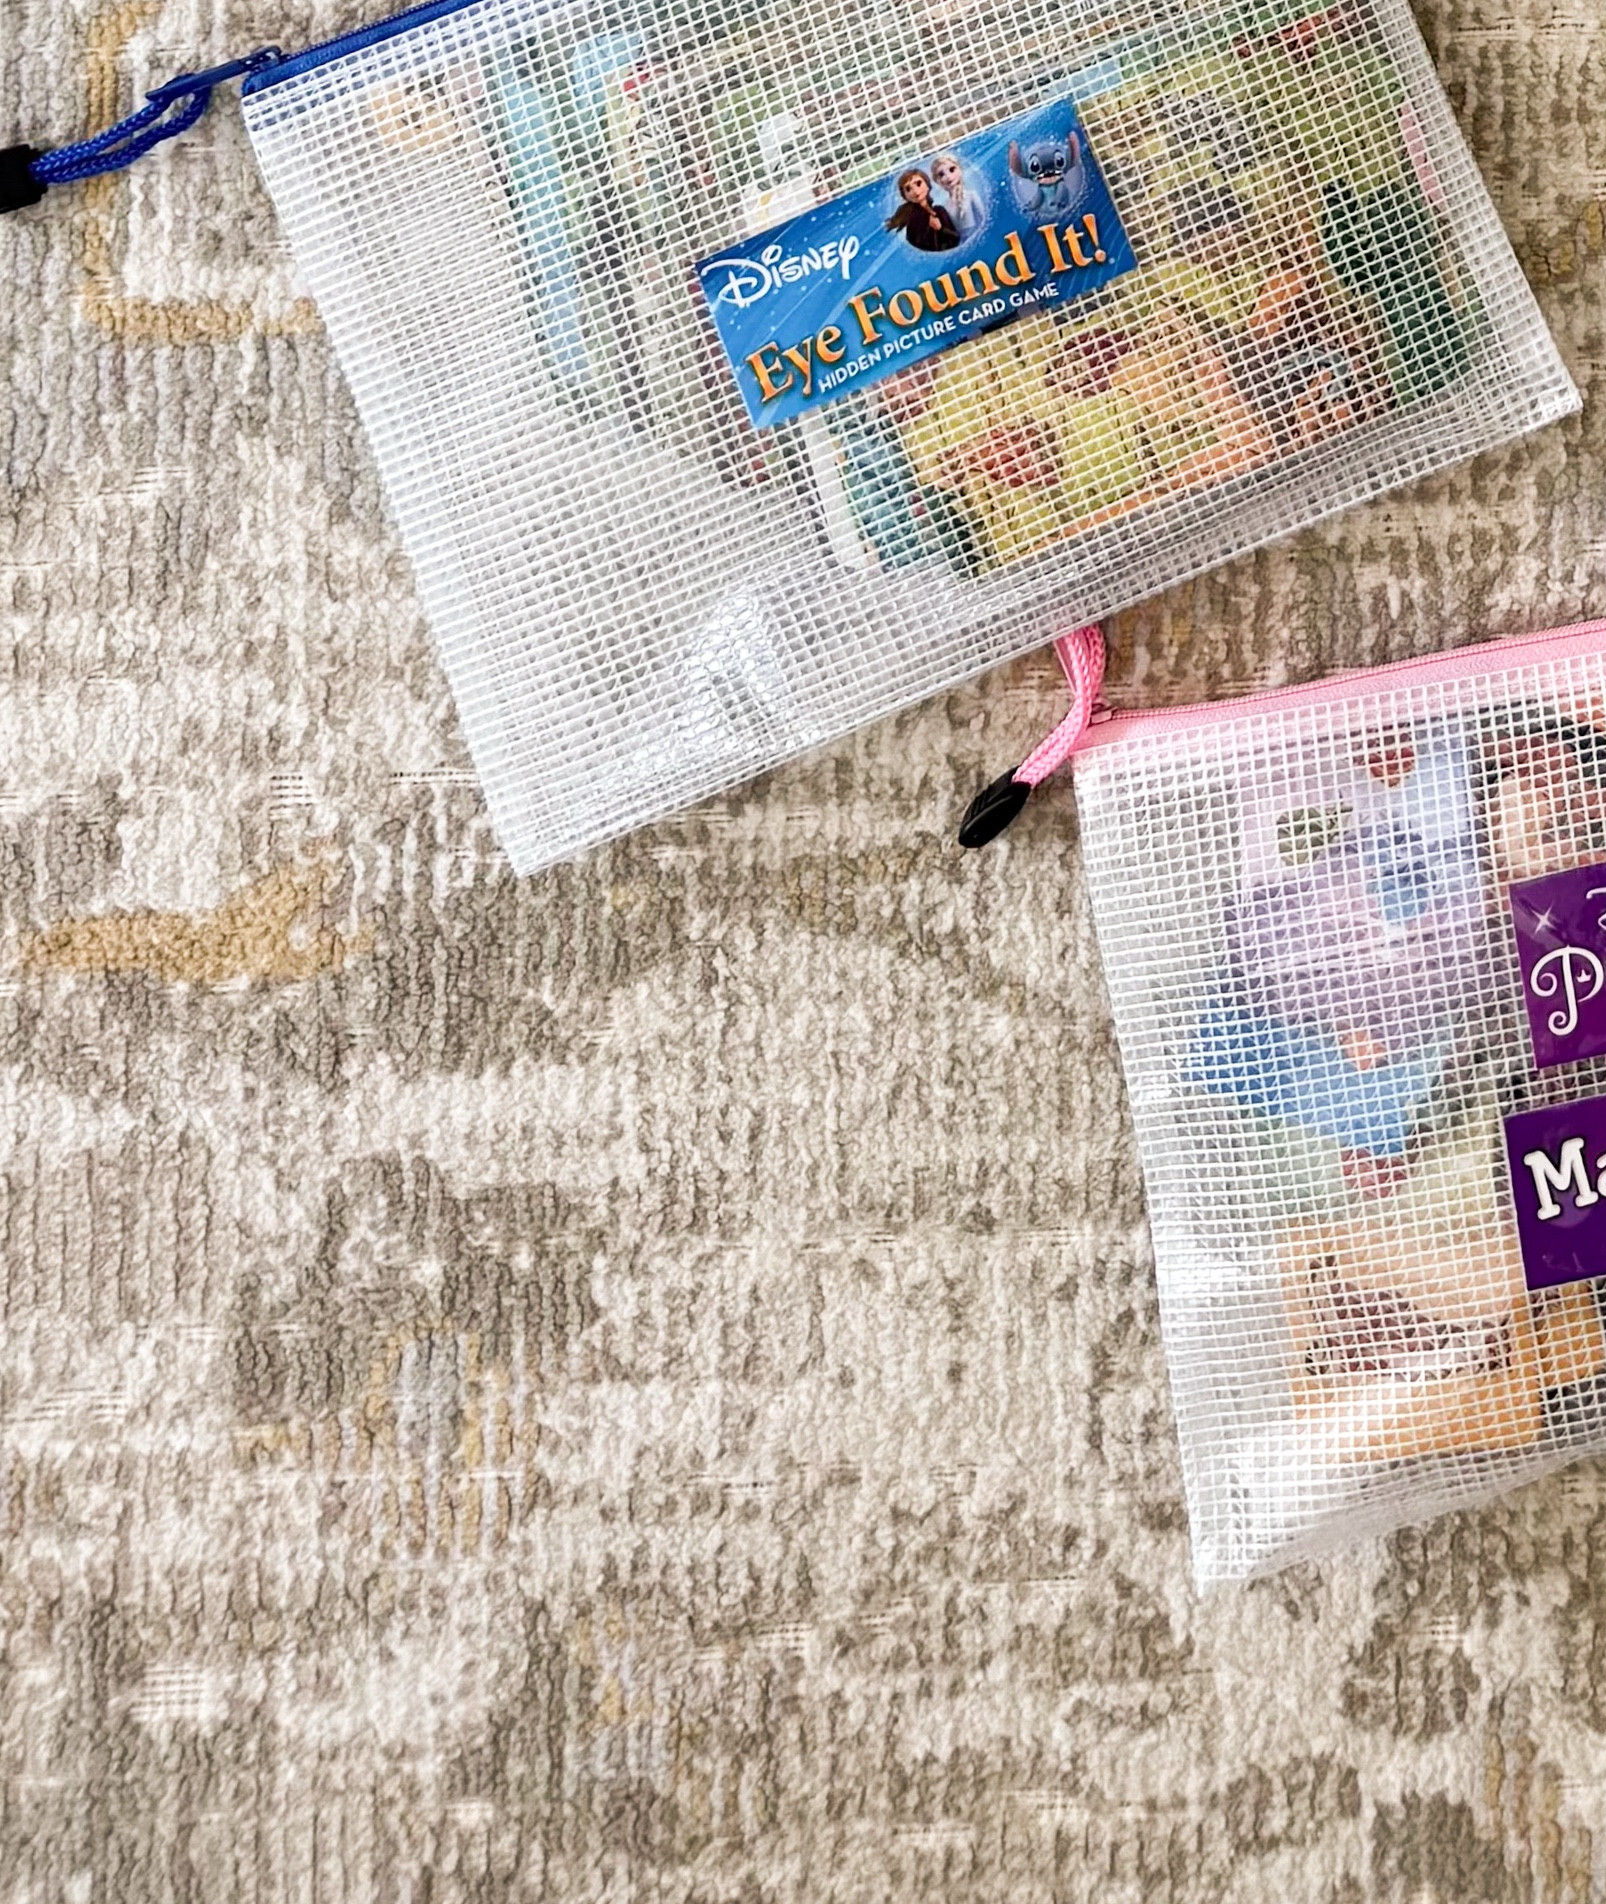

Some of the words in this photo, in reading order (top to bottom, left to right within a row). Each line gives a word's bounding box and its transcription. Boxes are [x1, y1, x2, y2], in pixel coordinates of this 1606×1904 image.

[700, 235, 860, 309] Disney
[744, 321, 847, 405] Eye
[849, 230, 1036, 347] Found
[1037, 213, 1107, 276] It!
[818, 348, 883, 394] HIDDEN
[882, 315, 957, 358] PICTURE
[958, 297, 1006, 326] CARD
[1008, 281, 1060, 310] GAME
